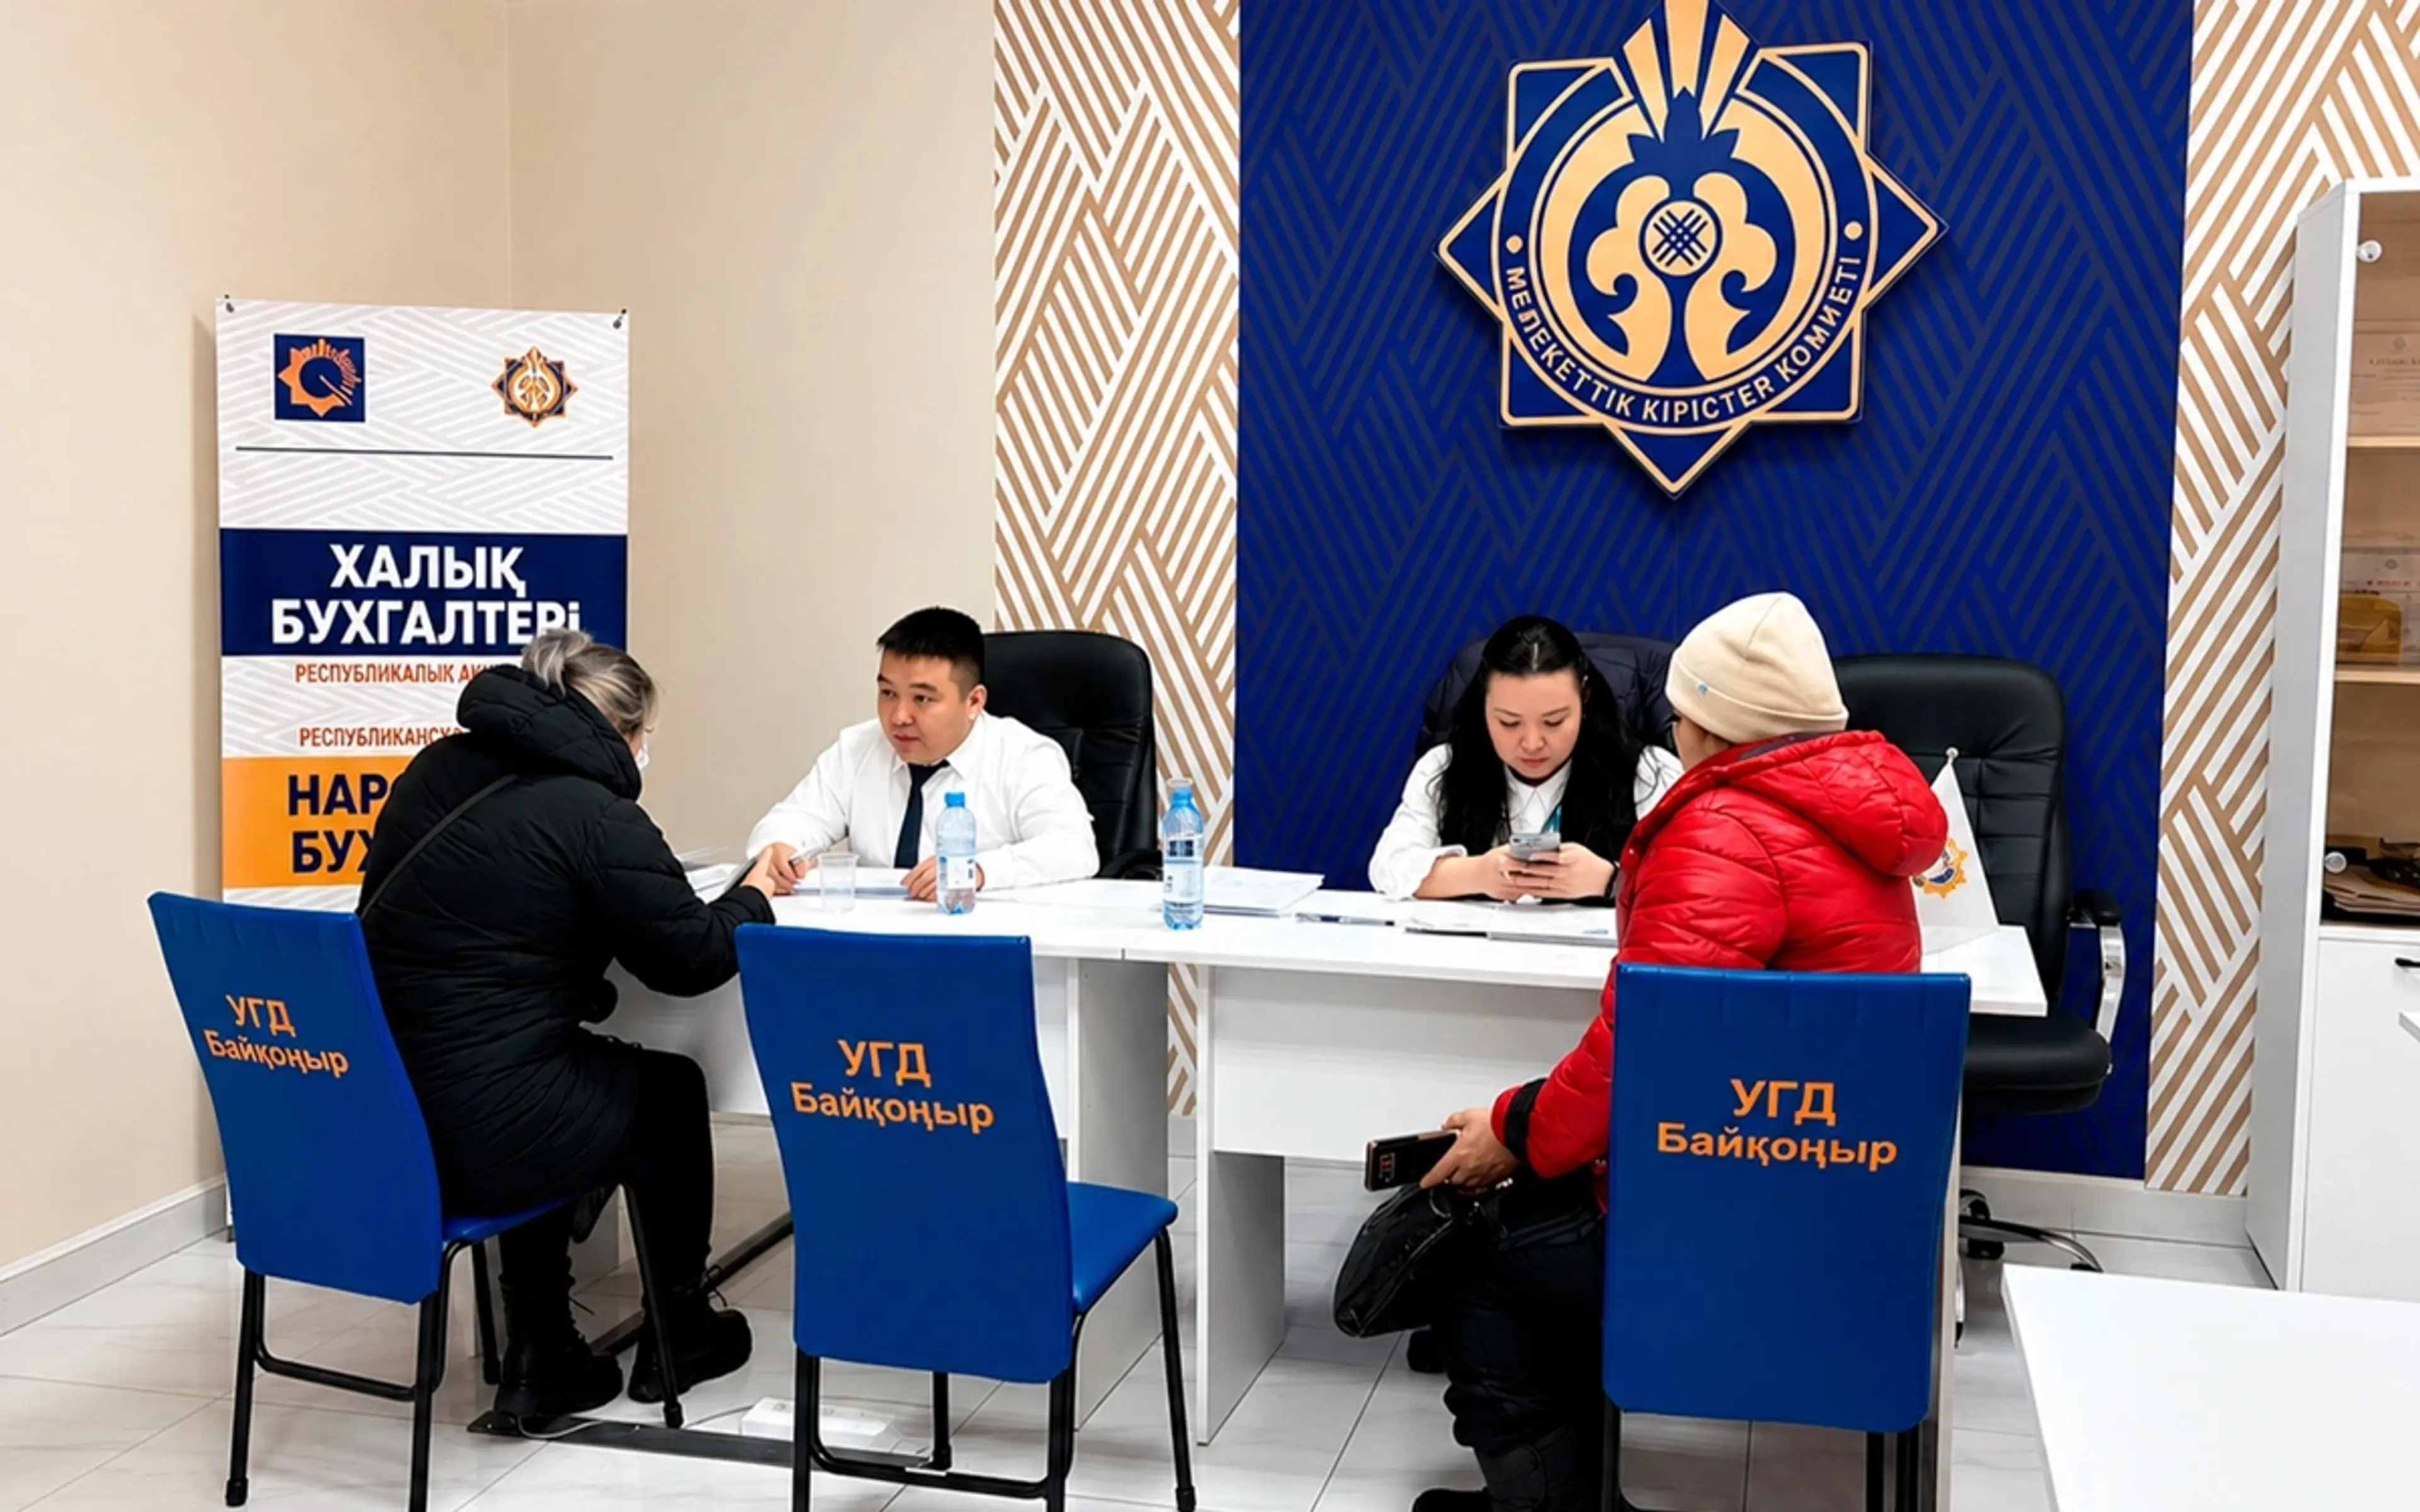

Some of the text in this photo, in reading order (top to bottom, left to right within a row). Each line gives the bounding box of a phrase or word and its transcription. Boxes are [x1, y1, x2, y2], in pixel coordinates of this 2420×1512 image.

[330, 544, 526, 598] ХАЛЫҚ
[289, 774, 388, 815] НАР
[226, 994, 296, 1038] УГД
[204, 1029, 349, 1079] Байқоңыр
[838, 1039, 931, 1088] УГД
[791, 1081, 994, 1134] Байқоңыр
[1731, 1078, 1836, 1126] УГД
[1657, 1121, 1898, 1172] Байқоңыр
